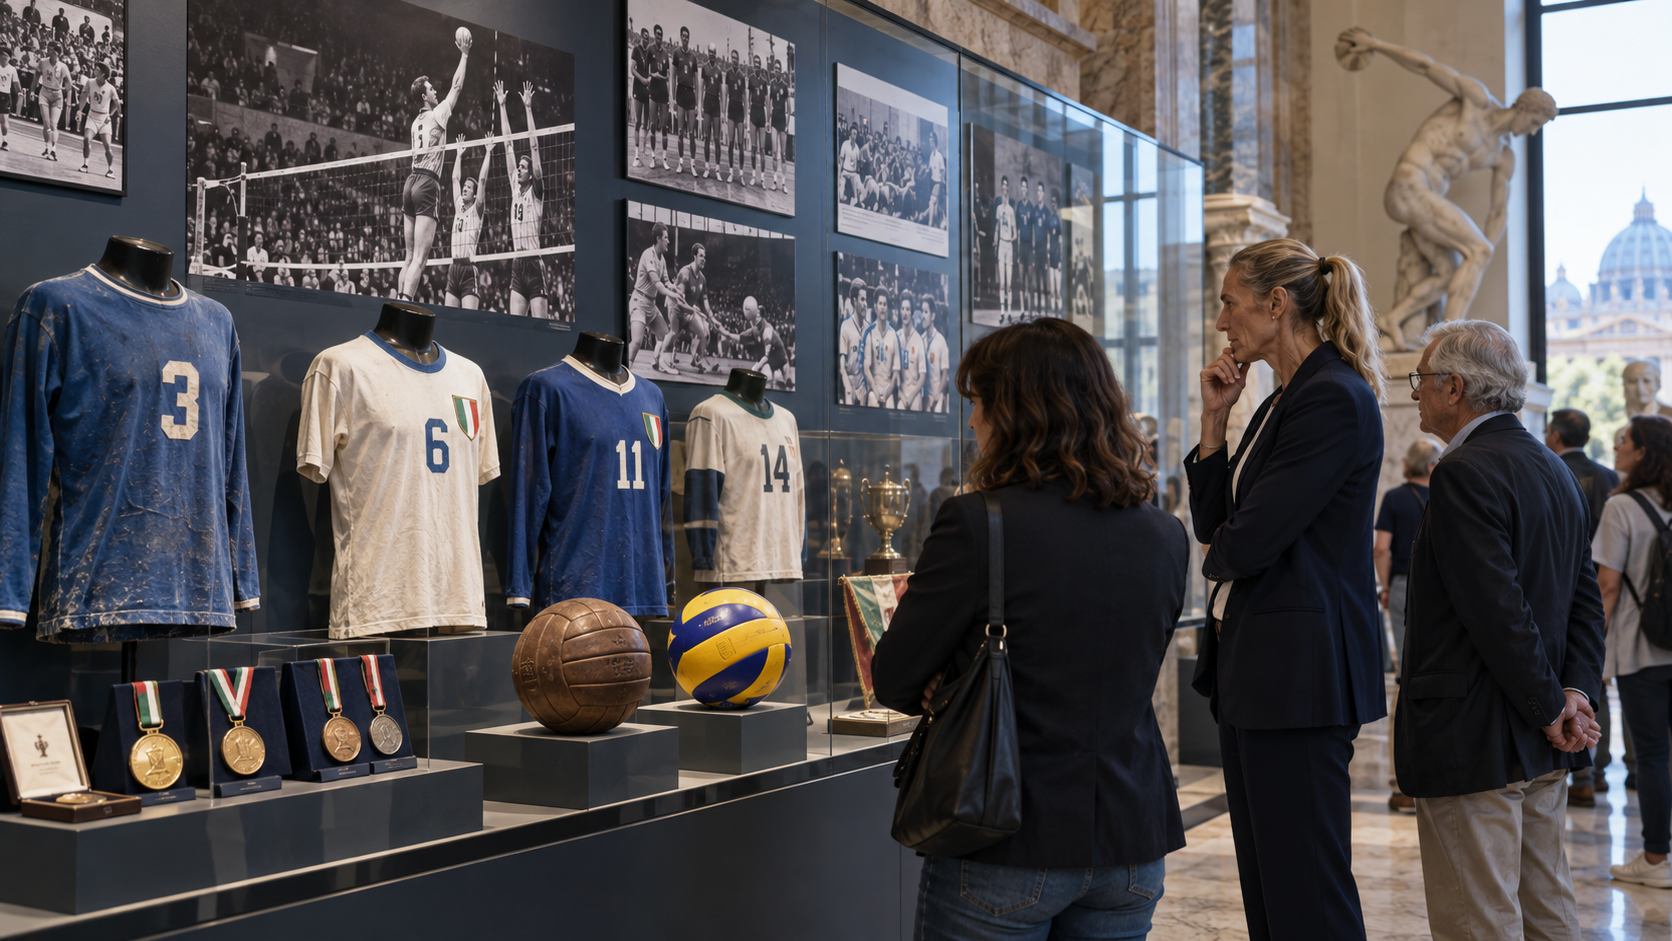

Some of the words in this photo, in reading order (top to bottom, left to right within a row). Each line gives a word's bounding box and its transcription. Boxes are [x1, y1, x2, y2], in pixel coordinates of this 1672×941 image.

[161, 360, 200, 440] 3
[425, 418, 450, 473] 6
[616, 439, 645, 490] 11
[760, 443, 790, 493] 14
